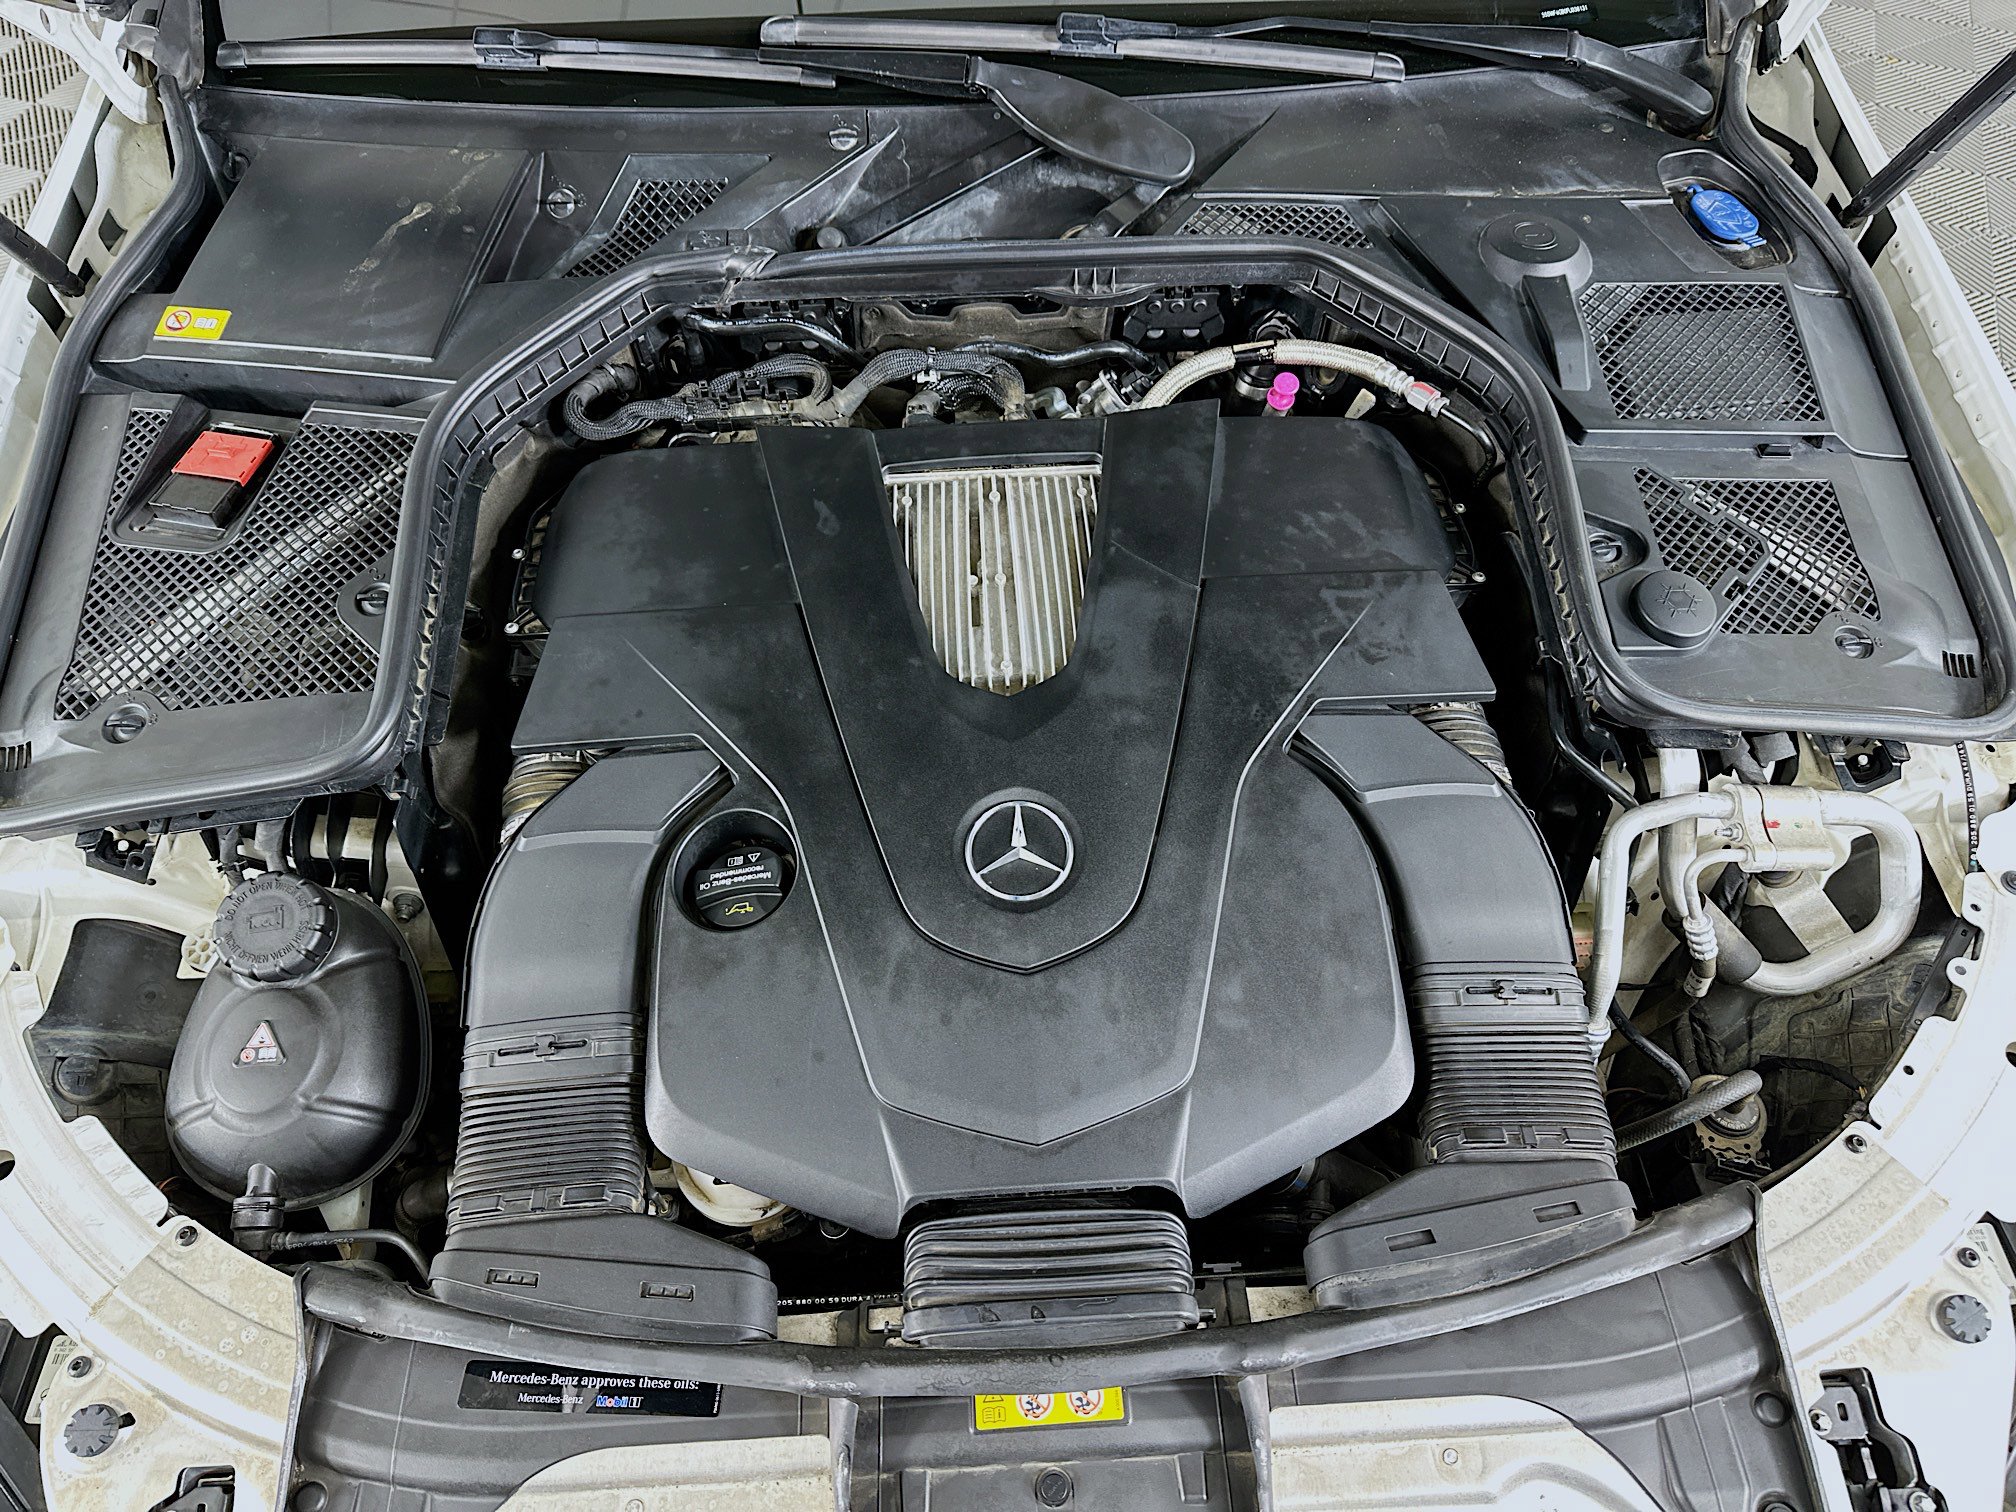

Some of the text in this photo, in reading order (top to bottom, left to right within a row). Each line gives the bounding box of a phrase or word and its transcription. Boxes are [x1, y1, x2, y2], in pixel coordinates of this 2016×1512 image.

[1964, 772, 1973, 792] DURA
[1967, 792, 1975, 802] 59
[1968, 804, 1976, 813] 01
[1970, 831, 1978, 845] 205
[710, 865, 765, 880] recommended
[699, 871, 772, 891] Mercedes-Benz Oil
[224, 908, 236, 922] DO
[233, 890, 249, 910] NOT
[248, 881, 273, 895] OPEN
[274, 880, 298, 897] WHEN
[223, 930, 242, 954] NICHT
[269, 942, 295, 961] WENN
[293, 920, 310, 945] HEISS
[841, 1295, 864, 1303] DURA
[489, 1370, 700, 1390] Mercedes-Benz approves these oils:
[517, 1392, 584, 1405] Mercedes-Benz
[596, 1395, 629, 1408] Mobil
